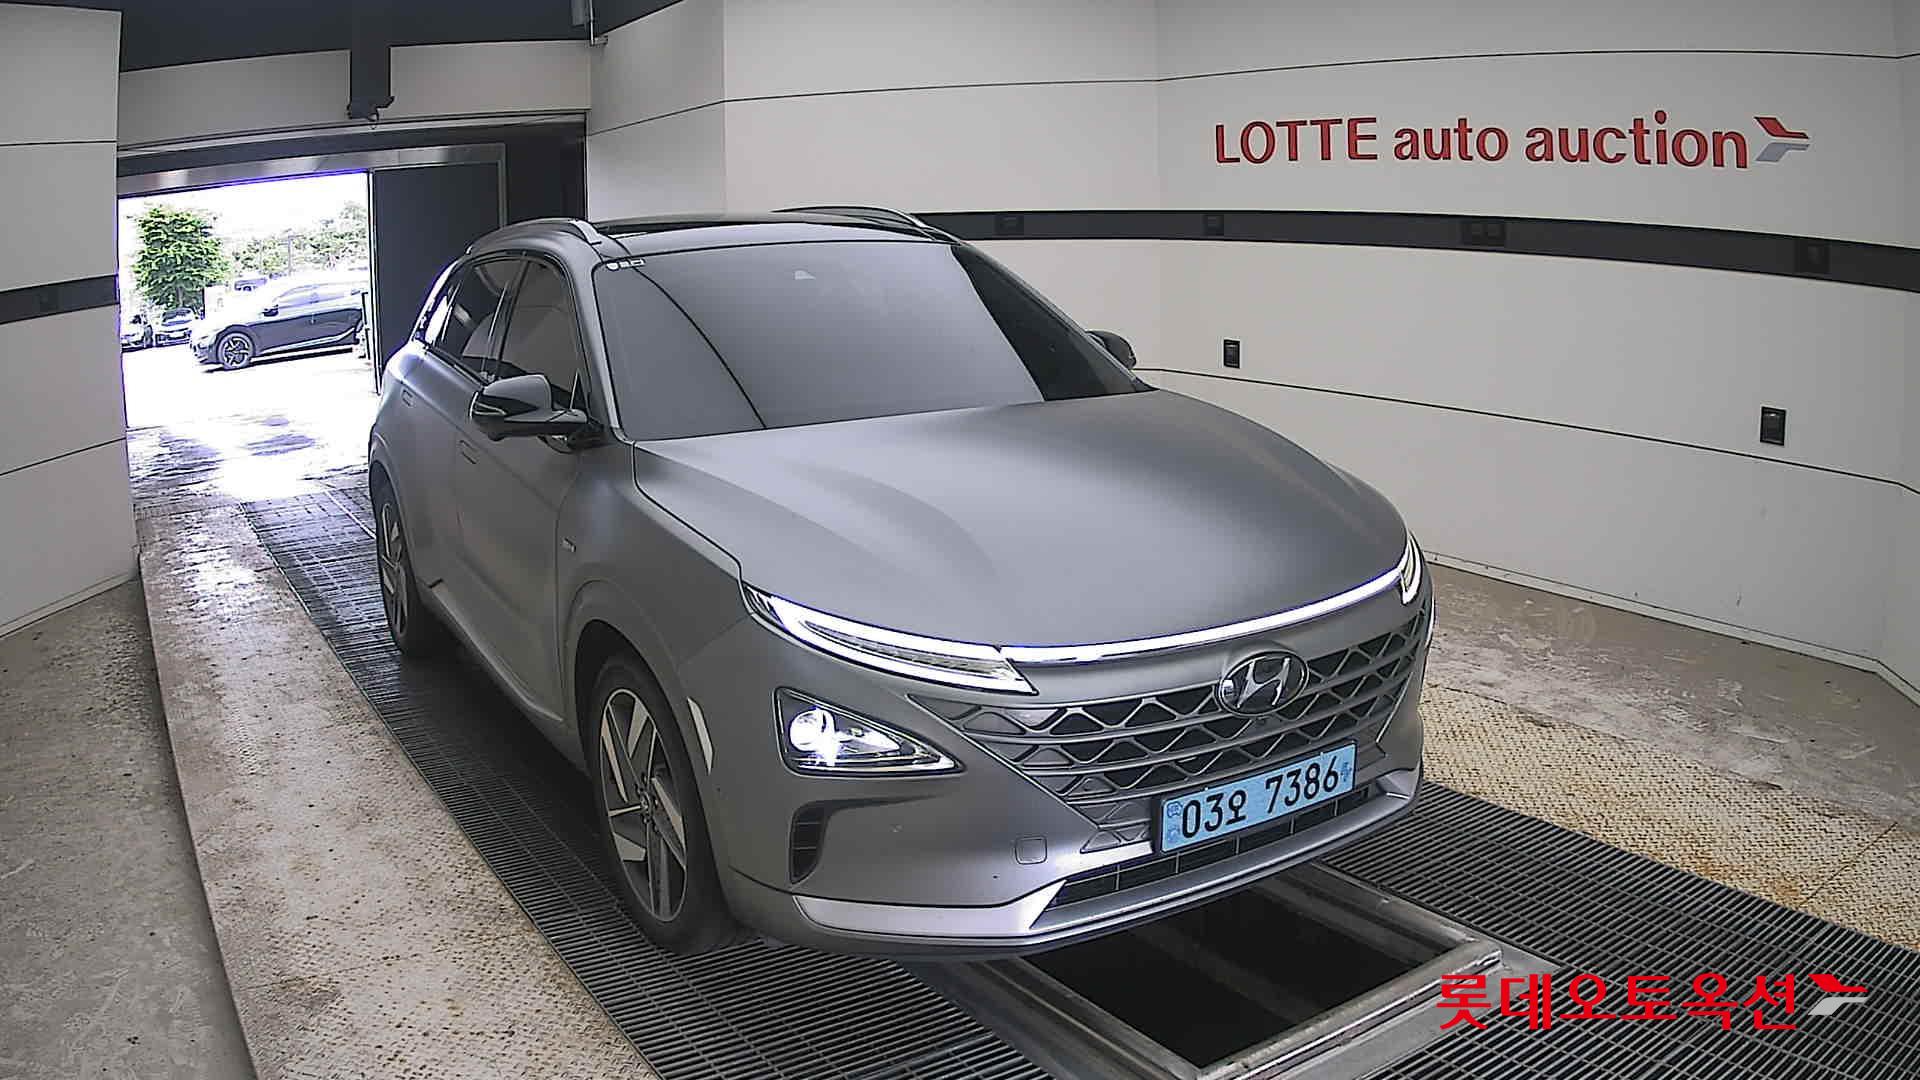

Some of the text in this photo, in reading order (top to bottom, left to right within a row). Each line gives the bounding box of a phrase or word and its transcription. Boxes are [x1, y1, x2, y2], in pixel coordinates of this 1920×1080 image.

[1215, 110, 1749, 169] LOTTE auto auction
[1182, 755, 1339, 839] 03오 7386
